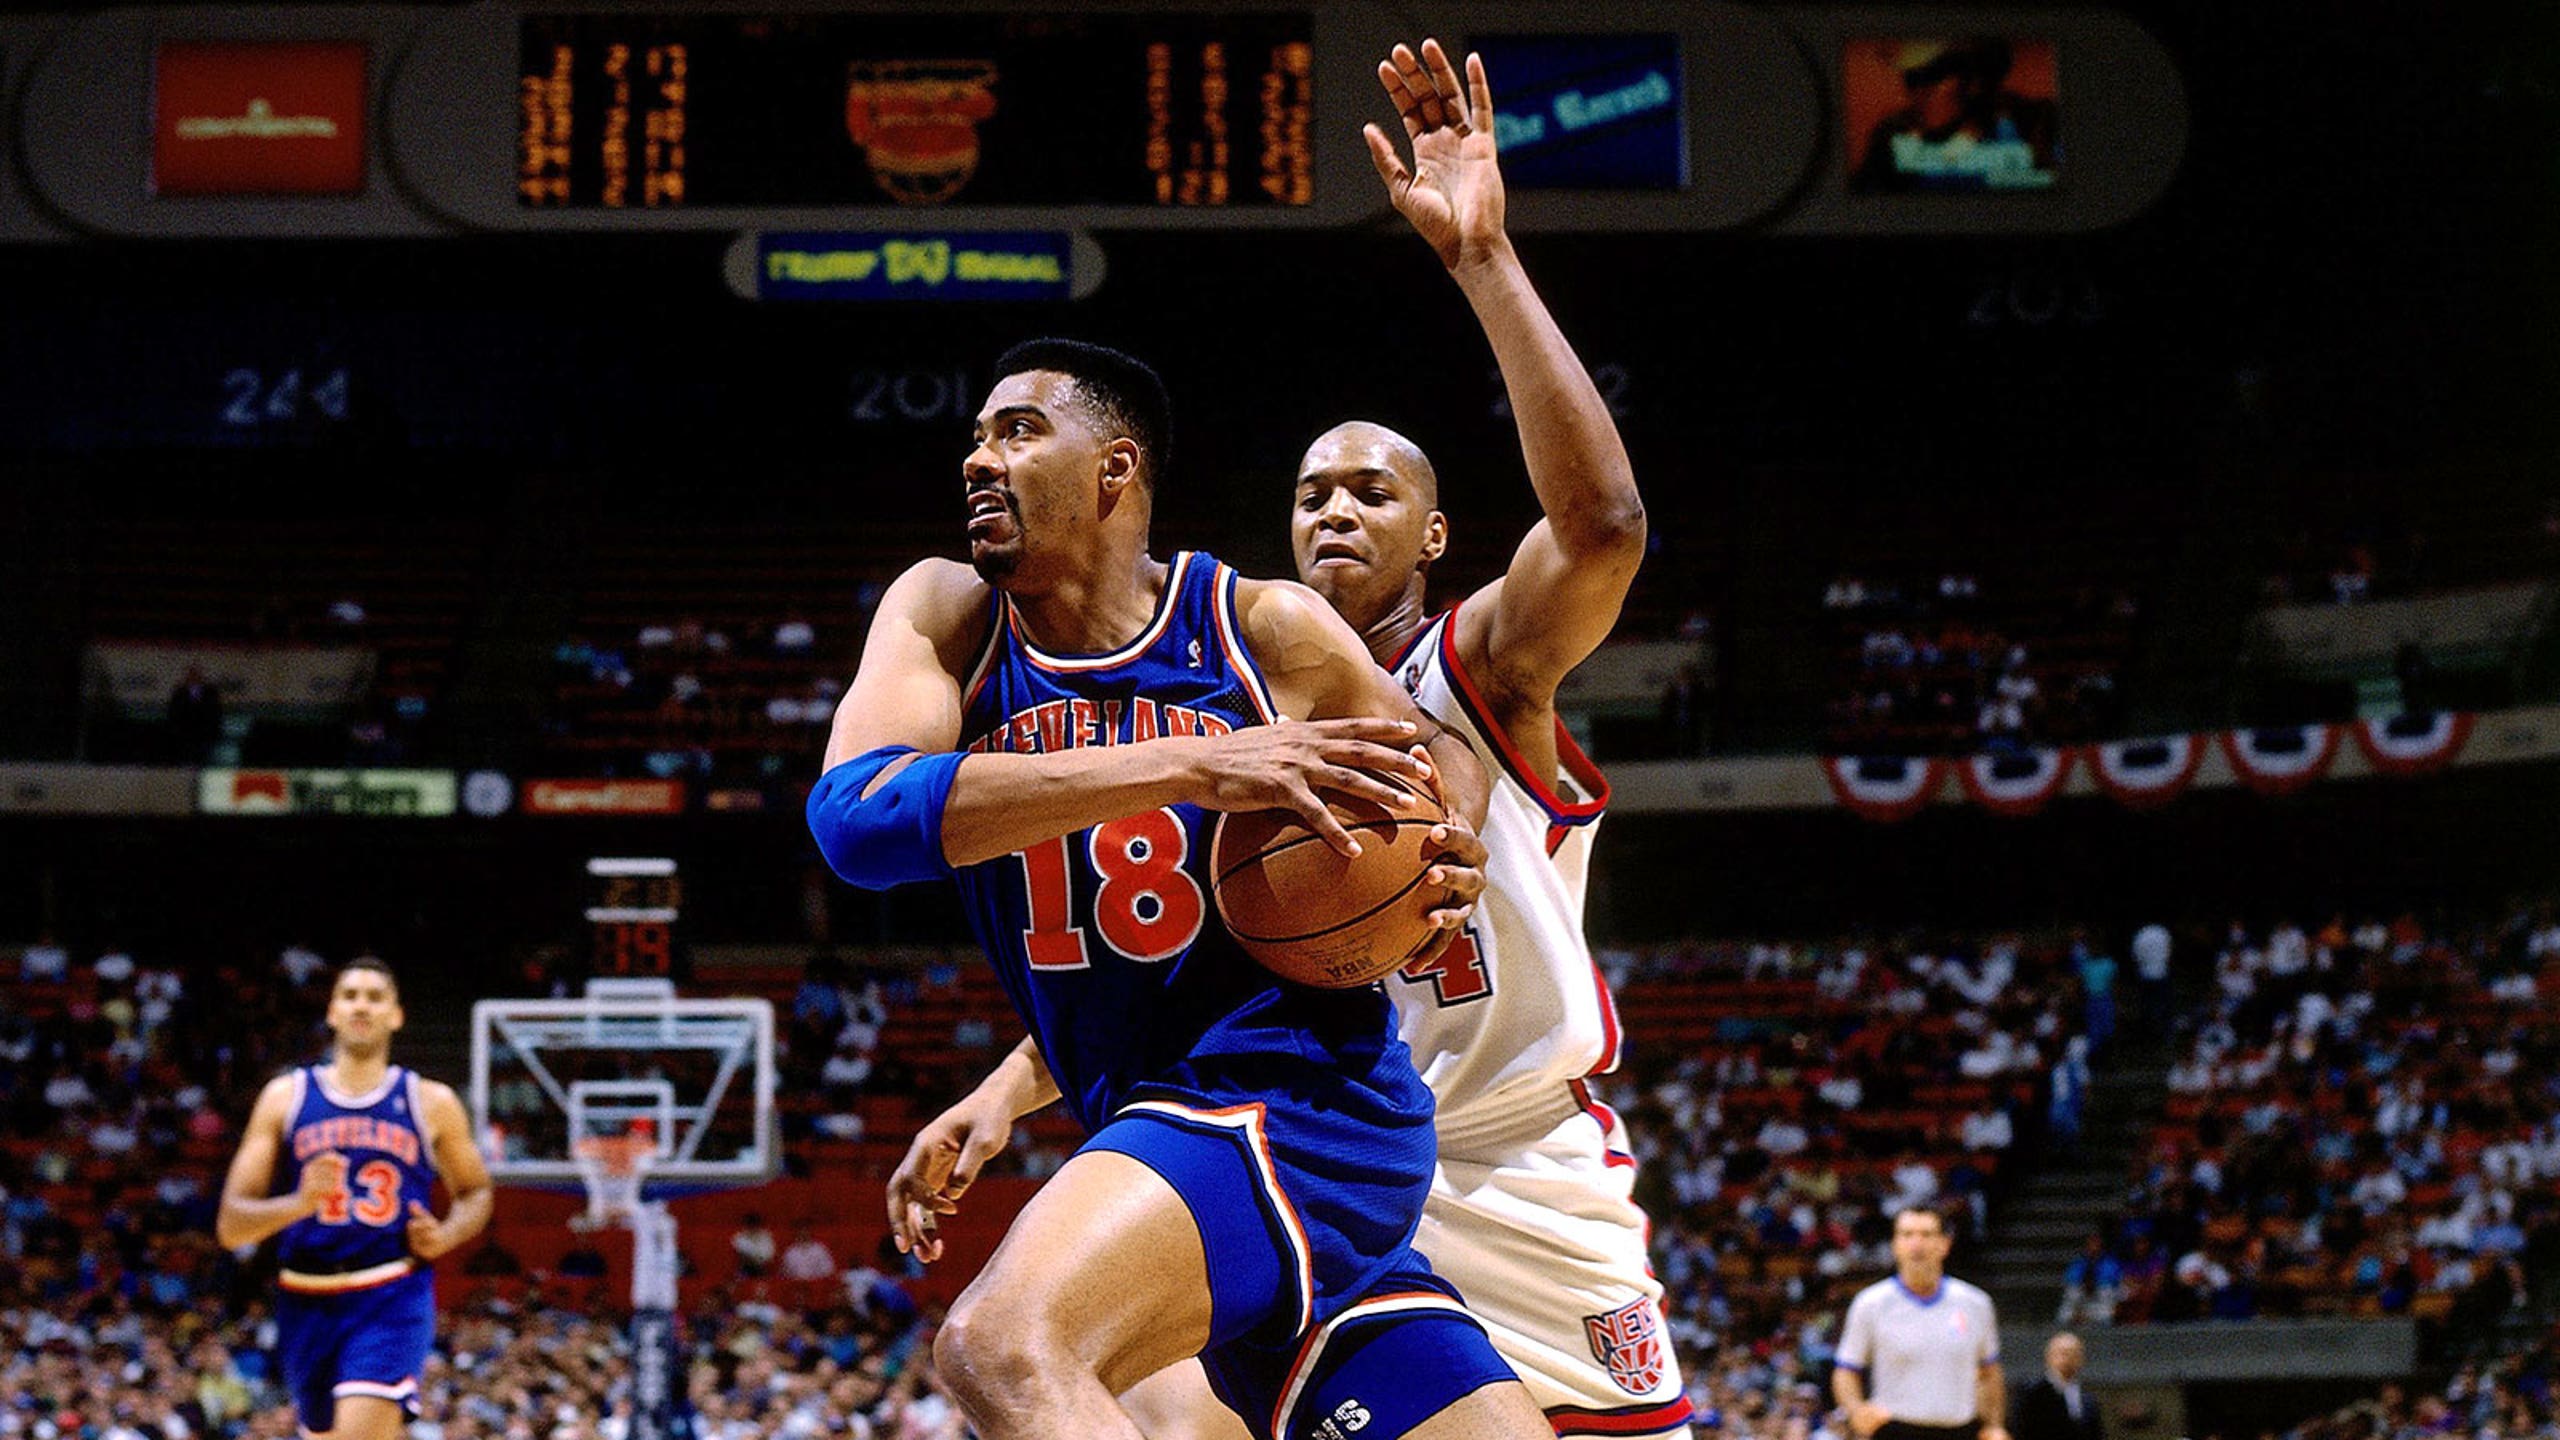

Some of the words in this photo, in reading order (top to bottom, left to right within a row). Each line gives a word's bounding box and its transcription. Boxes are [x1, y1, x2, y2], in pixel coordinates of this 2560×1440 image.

[1011, 802, 1205, 971] 18
[1325, 955, 1375, 979] NBA
[294, 1116, 418, 1165] CLEVELAND
